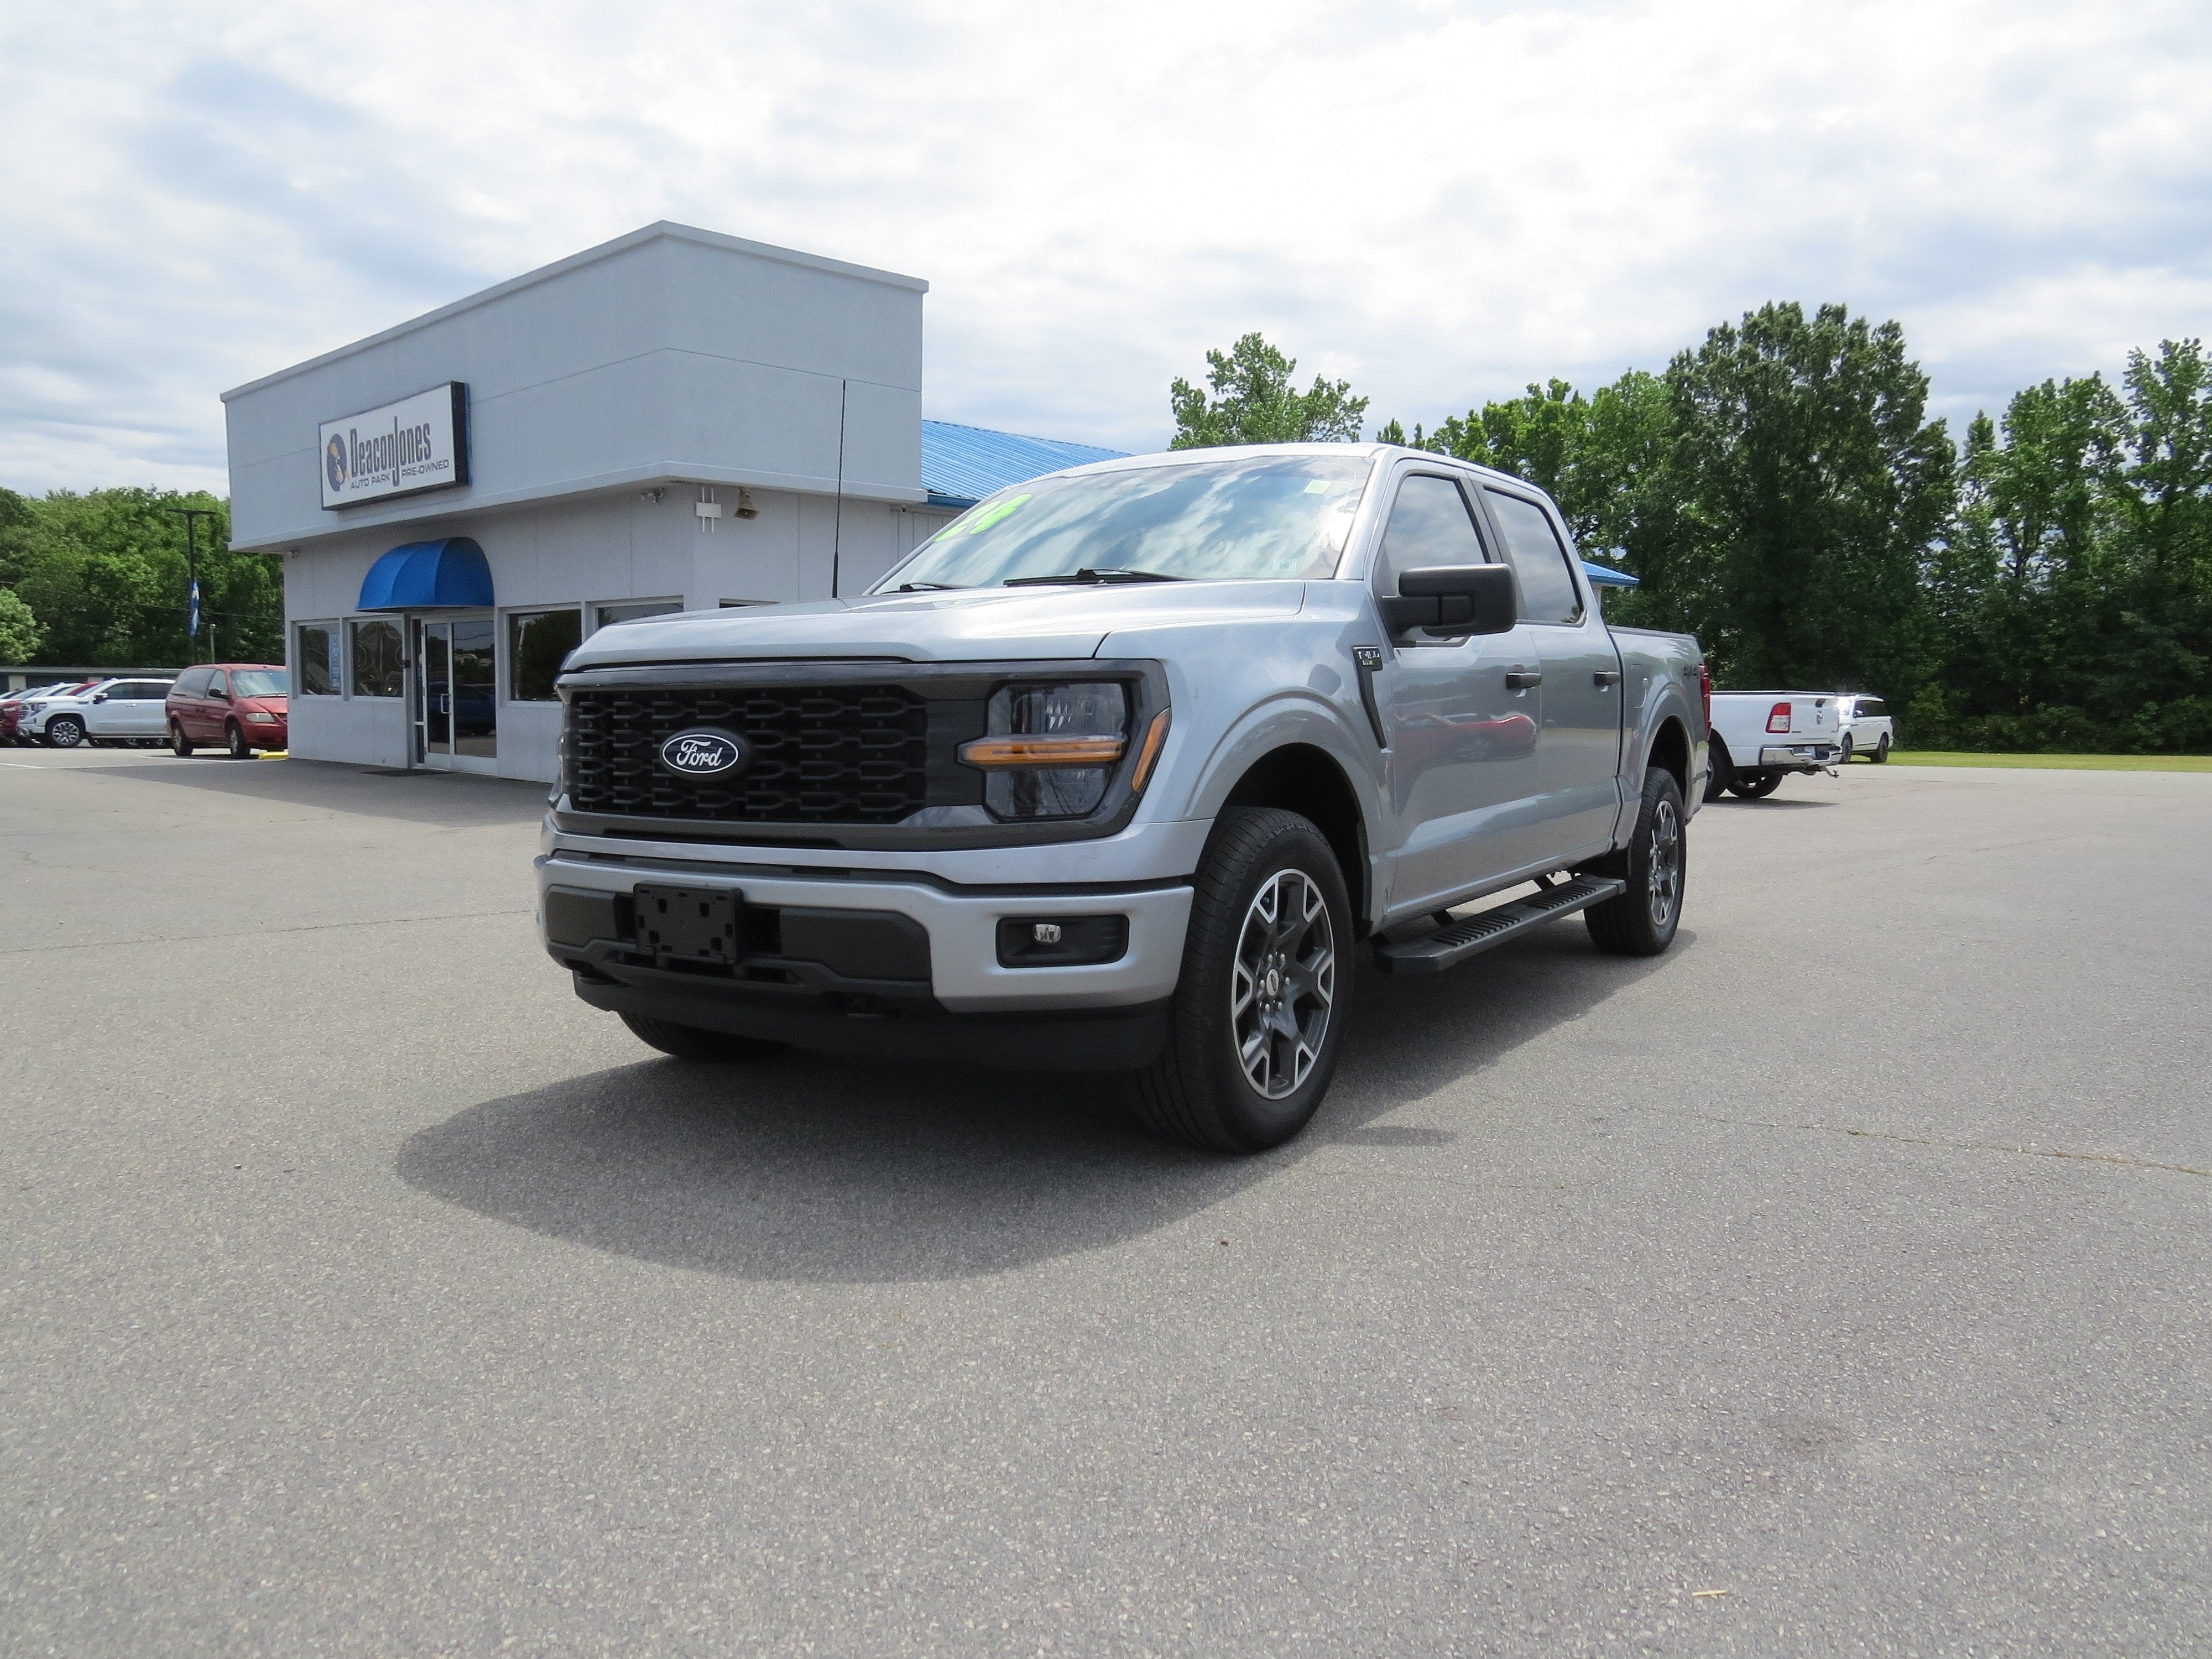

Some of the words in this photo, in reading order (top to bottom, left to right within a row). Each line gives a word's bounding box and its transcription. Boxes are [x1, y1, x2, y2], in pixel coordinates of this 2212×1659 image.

[351, 477, 369, 489] AUTO
[371, 473, 391, 484] PARK
[401, 459, 449, 477] PRE-OWNED
[676, 739, 723, 766] Ford
